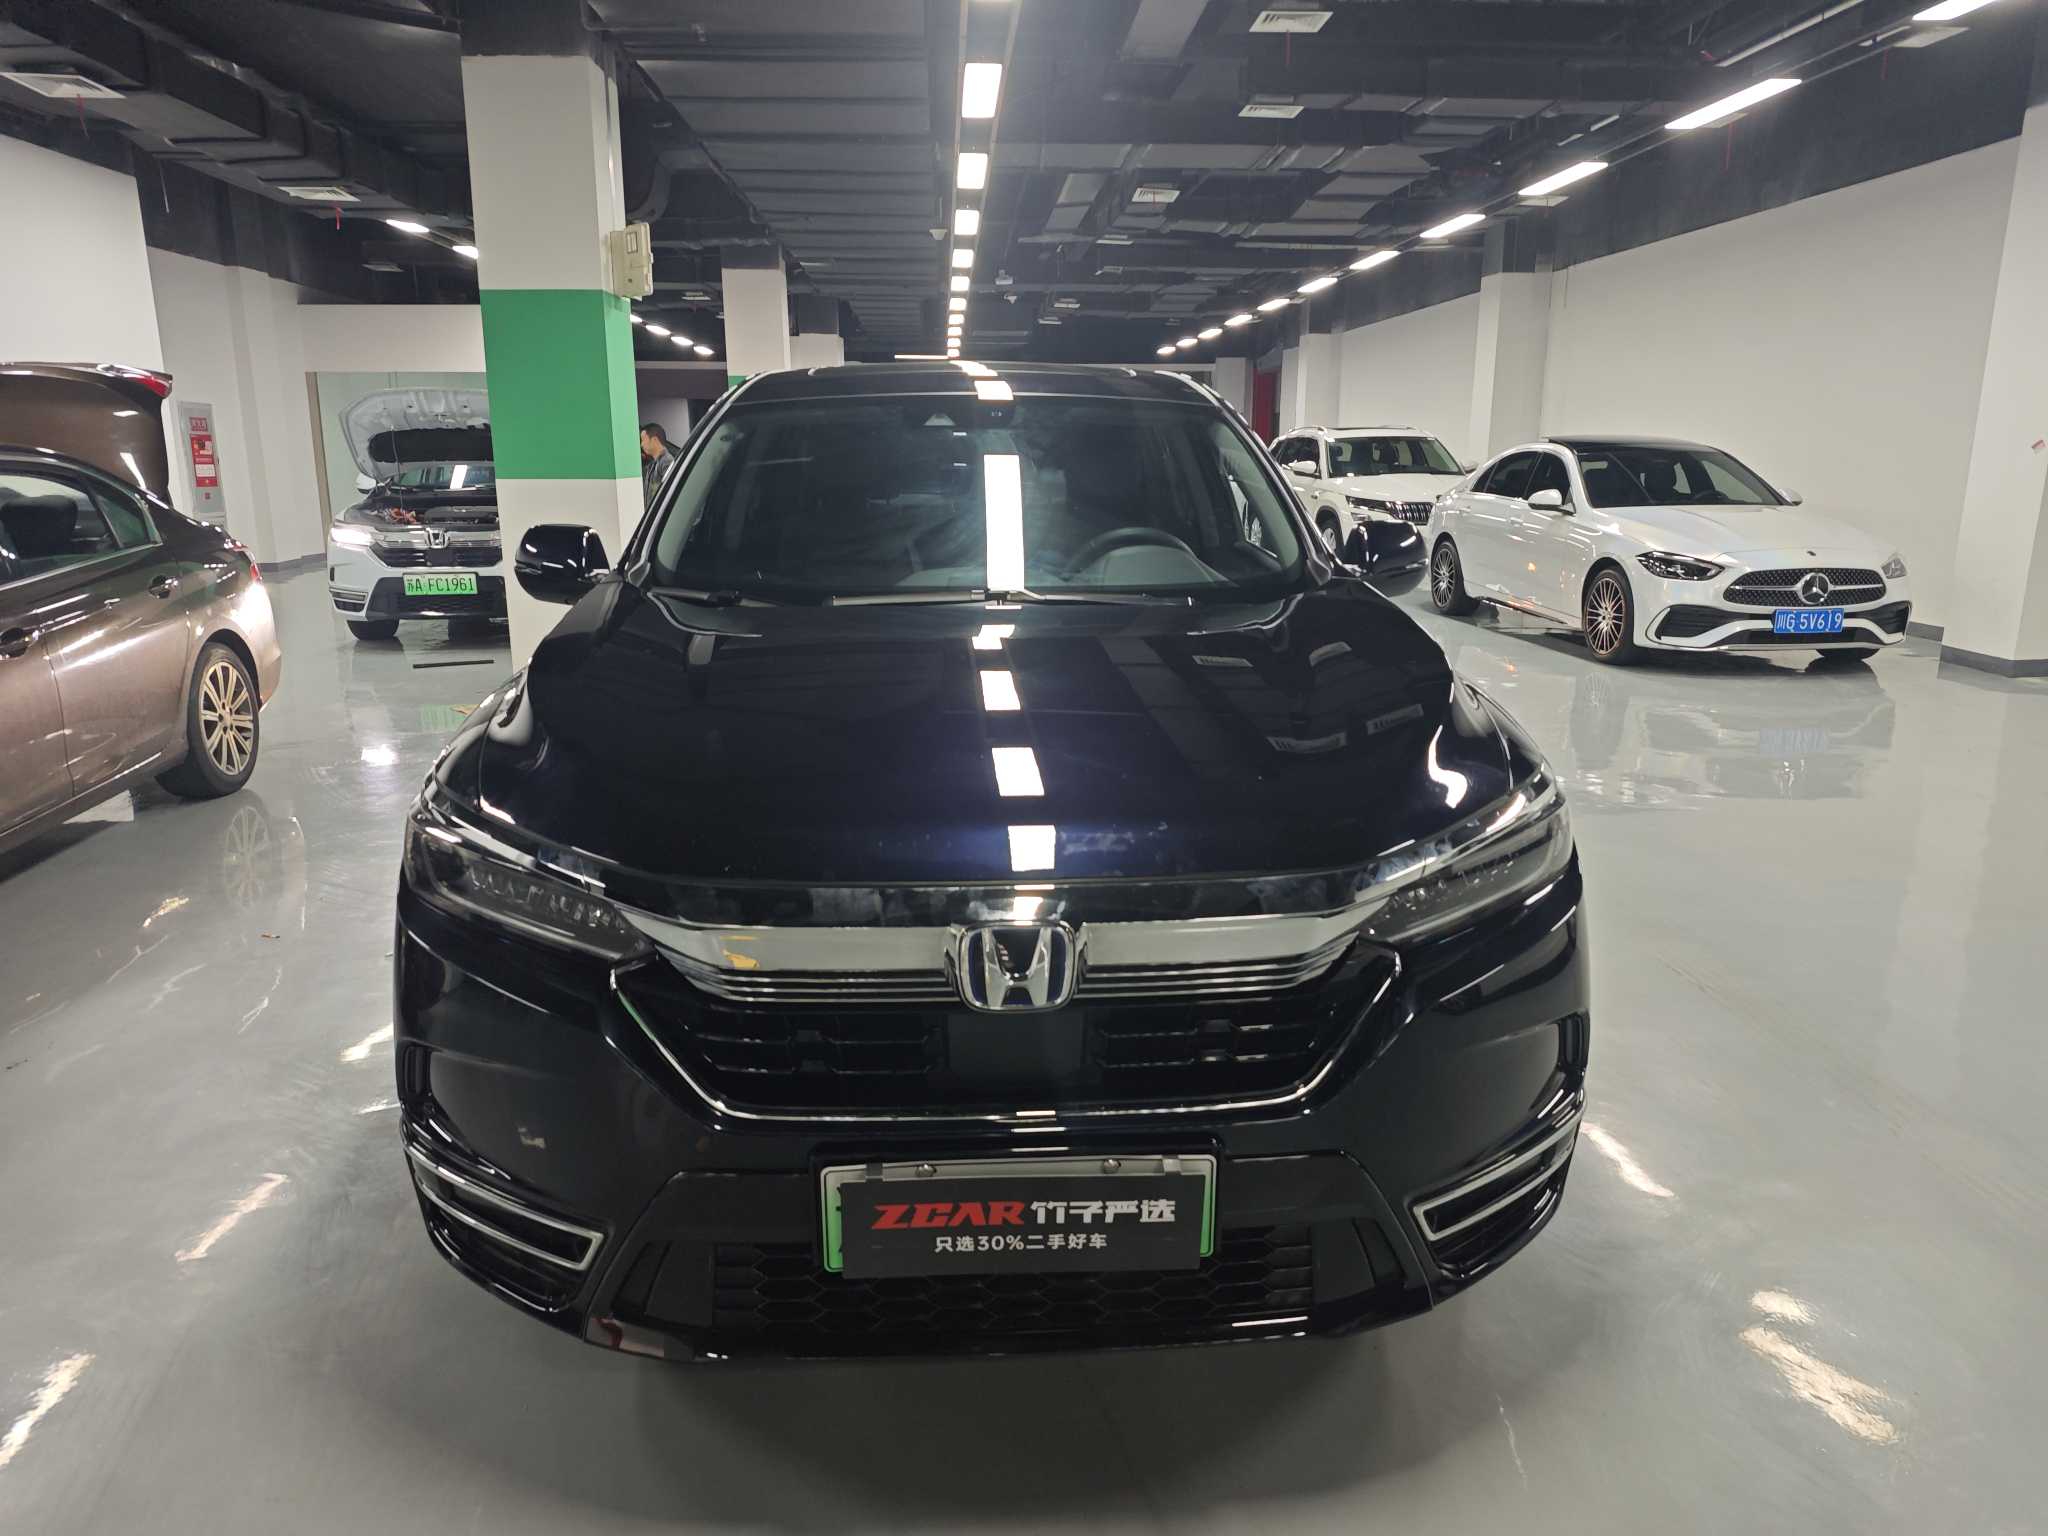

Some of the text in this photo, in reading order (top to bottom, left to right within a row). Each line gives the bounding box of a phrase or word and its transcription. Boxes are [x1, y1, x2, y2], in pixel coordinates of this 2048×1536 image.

[428, 577, 473, 592] FC1961
[1800, 612, 1842, 630] 5V619
[872, 1199, 1176, 1230] ZCAR 竹子严选
[935, 1233, 1108, 1252] 只选30%二手好车
